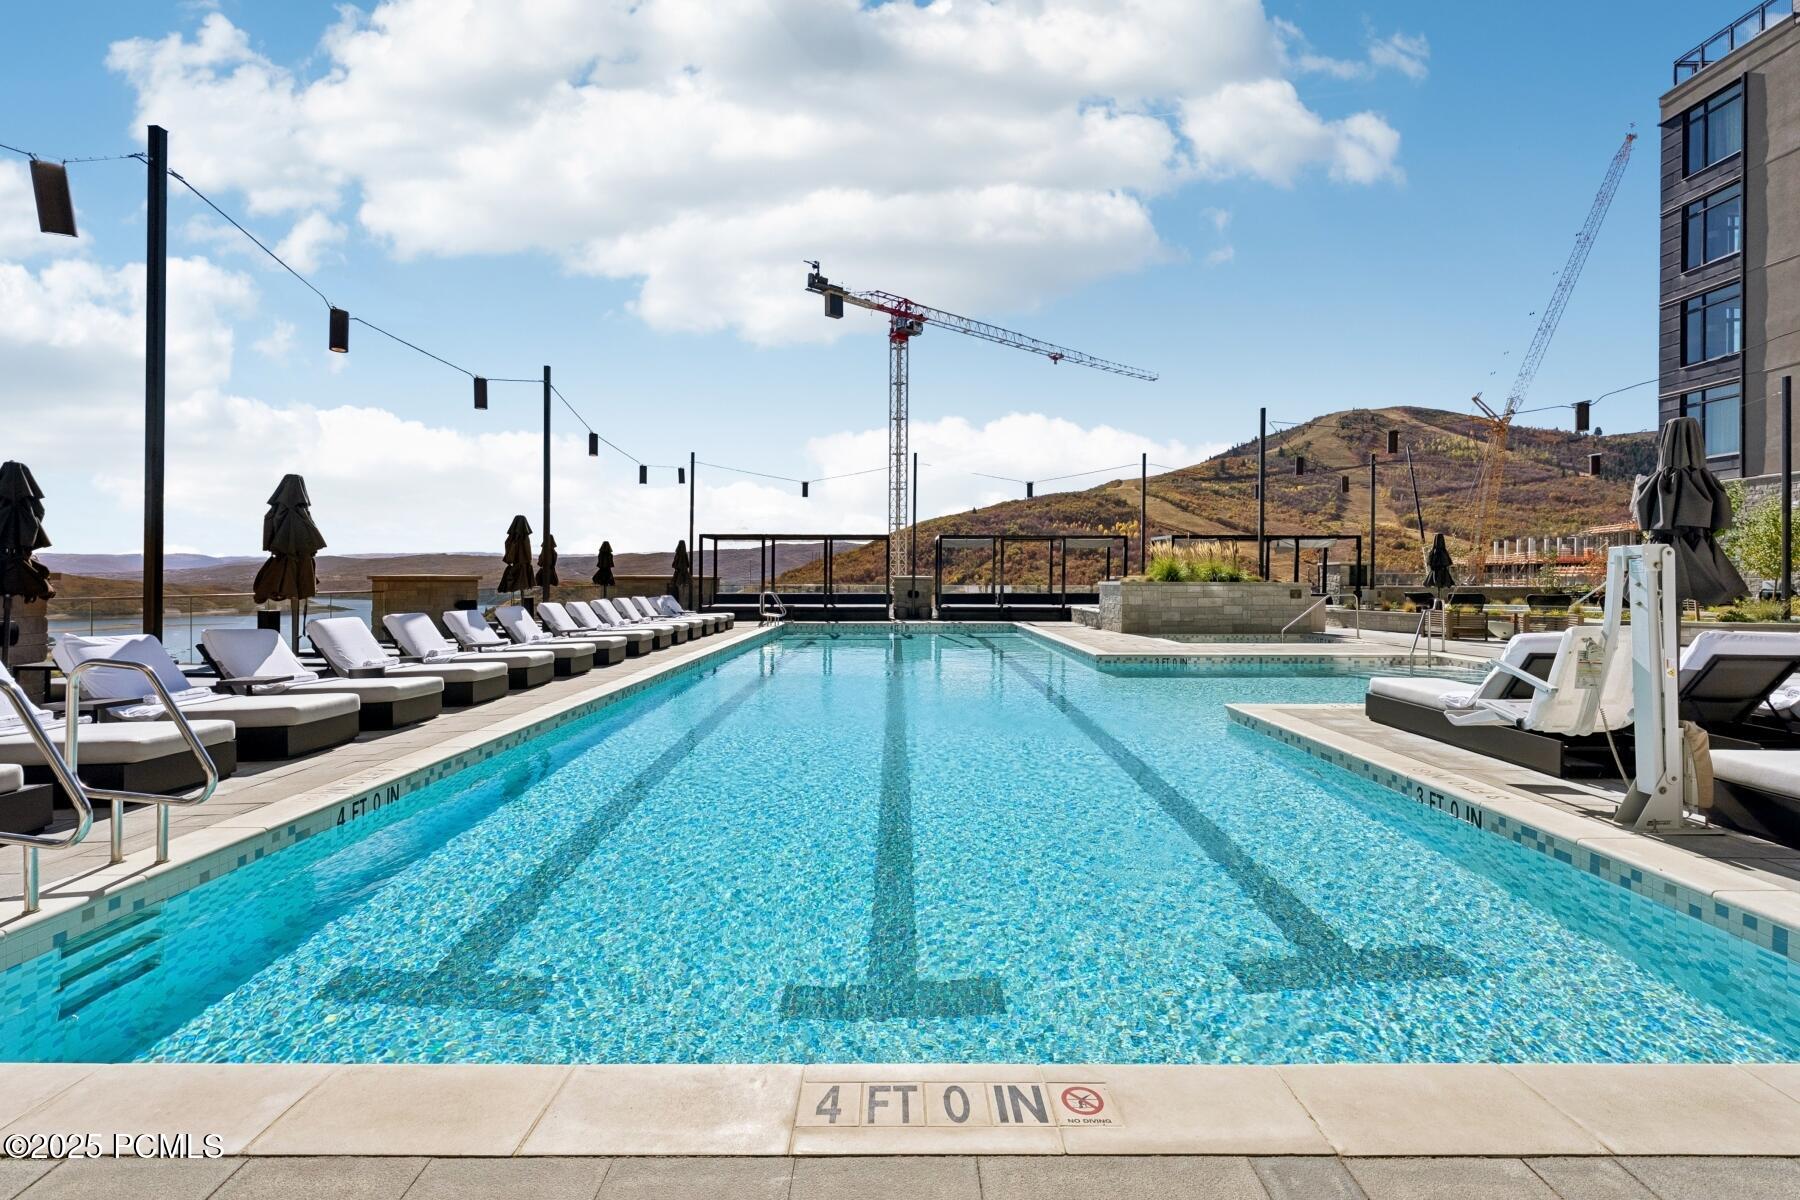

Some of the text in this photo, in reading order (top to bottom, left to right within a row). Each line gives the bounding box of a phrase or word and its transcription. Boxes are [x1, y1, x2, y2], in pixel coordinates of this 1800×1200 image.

[337, 806, 346, 825] 4
[352, 797, 367, 820] FT
[373, 792, 381, 810] 0
[386, 783, 399, 805] IN
[1416, 786, 1424, 804] 3
[1430, 791, 1444, 809] FT
[1466, 805, 1482, 829] IN
[815, 1085, 1049, 1123] 4 FT 0 IN
